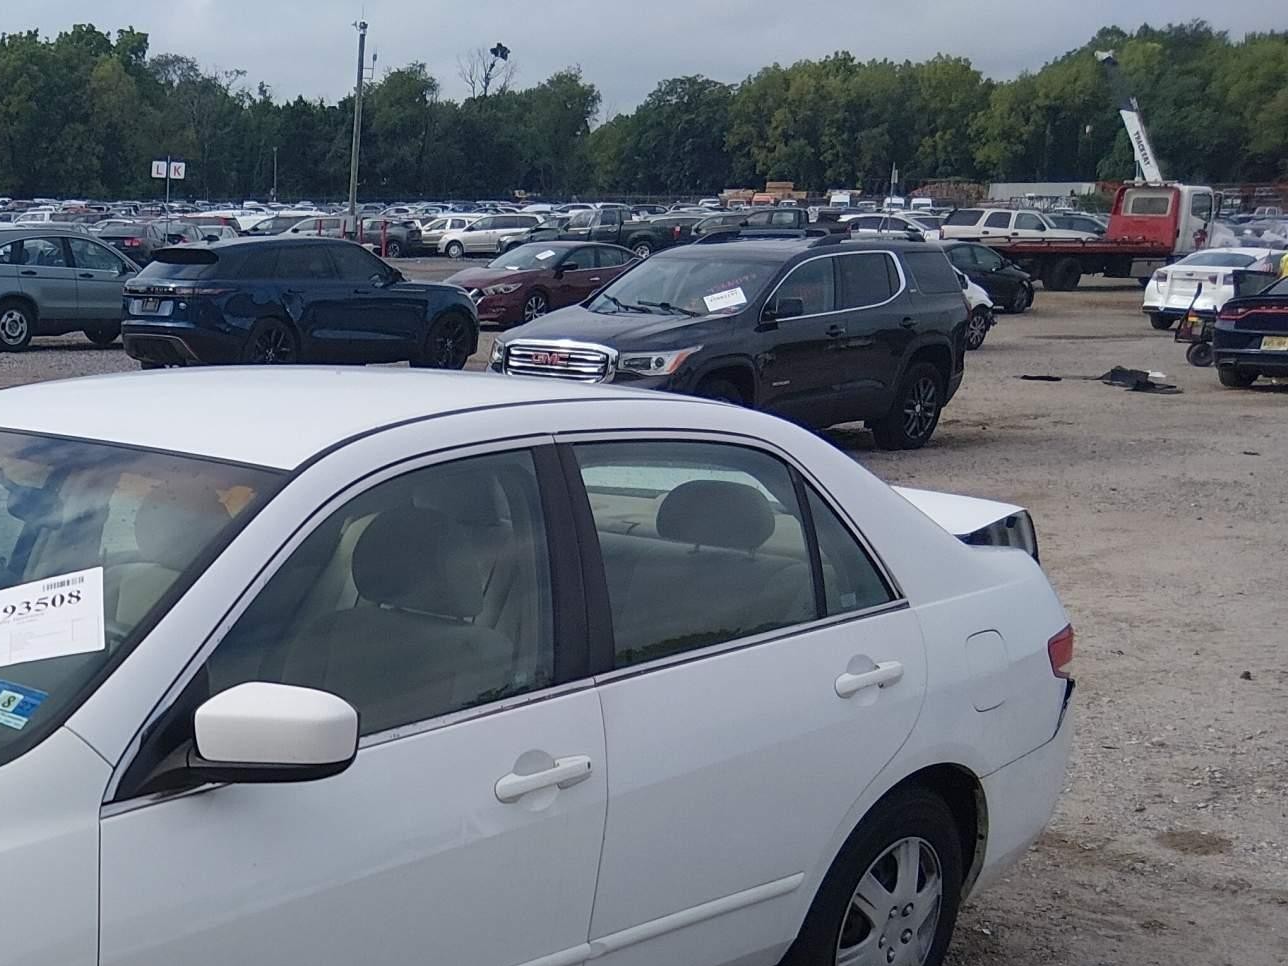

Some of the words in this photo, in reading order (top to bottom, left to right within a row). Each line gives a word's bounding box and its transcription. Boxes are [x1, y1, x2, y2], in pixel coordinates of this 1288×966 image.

[173, 165, 182, 177] K
[531, 351, 570, 366] GMC
[1, 694, 16, 709] 8
